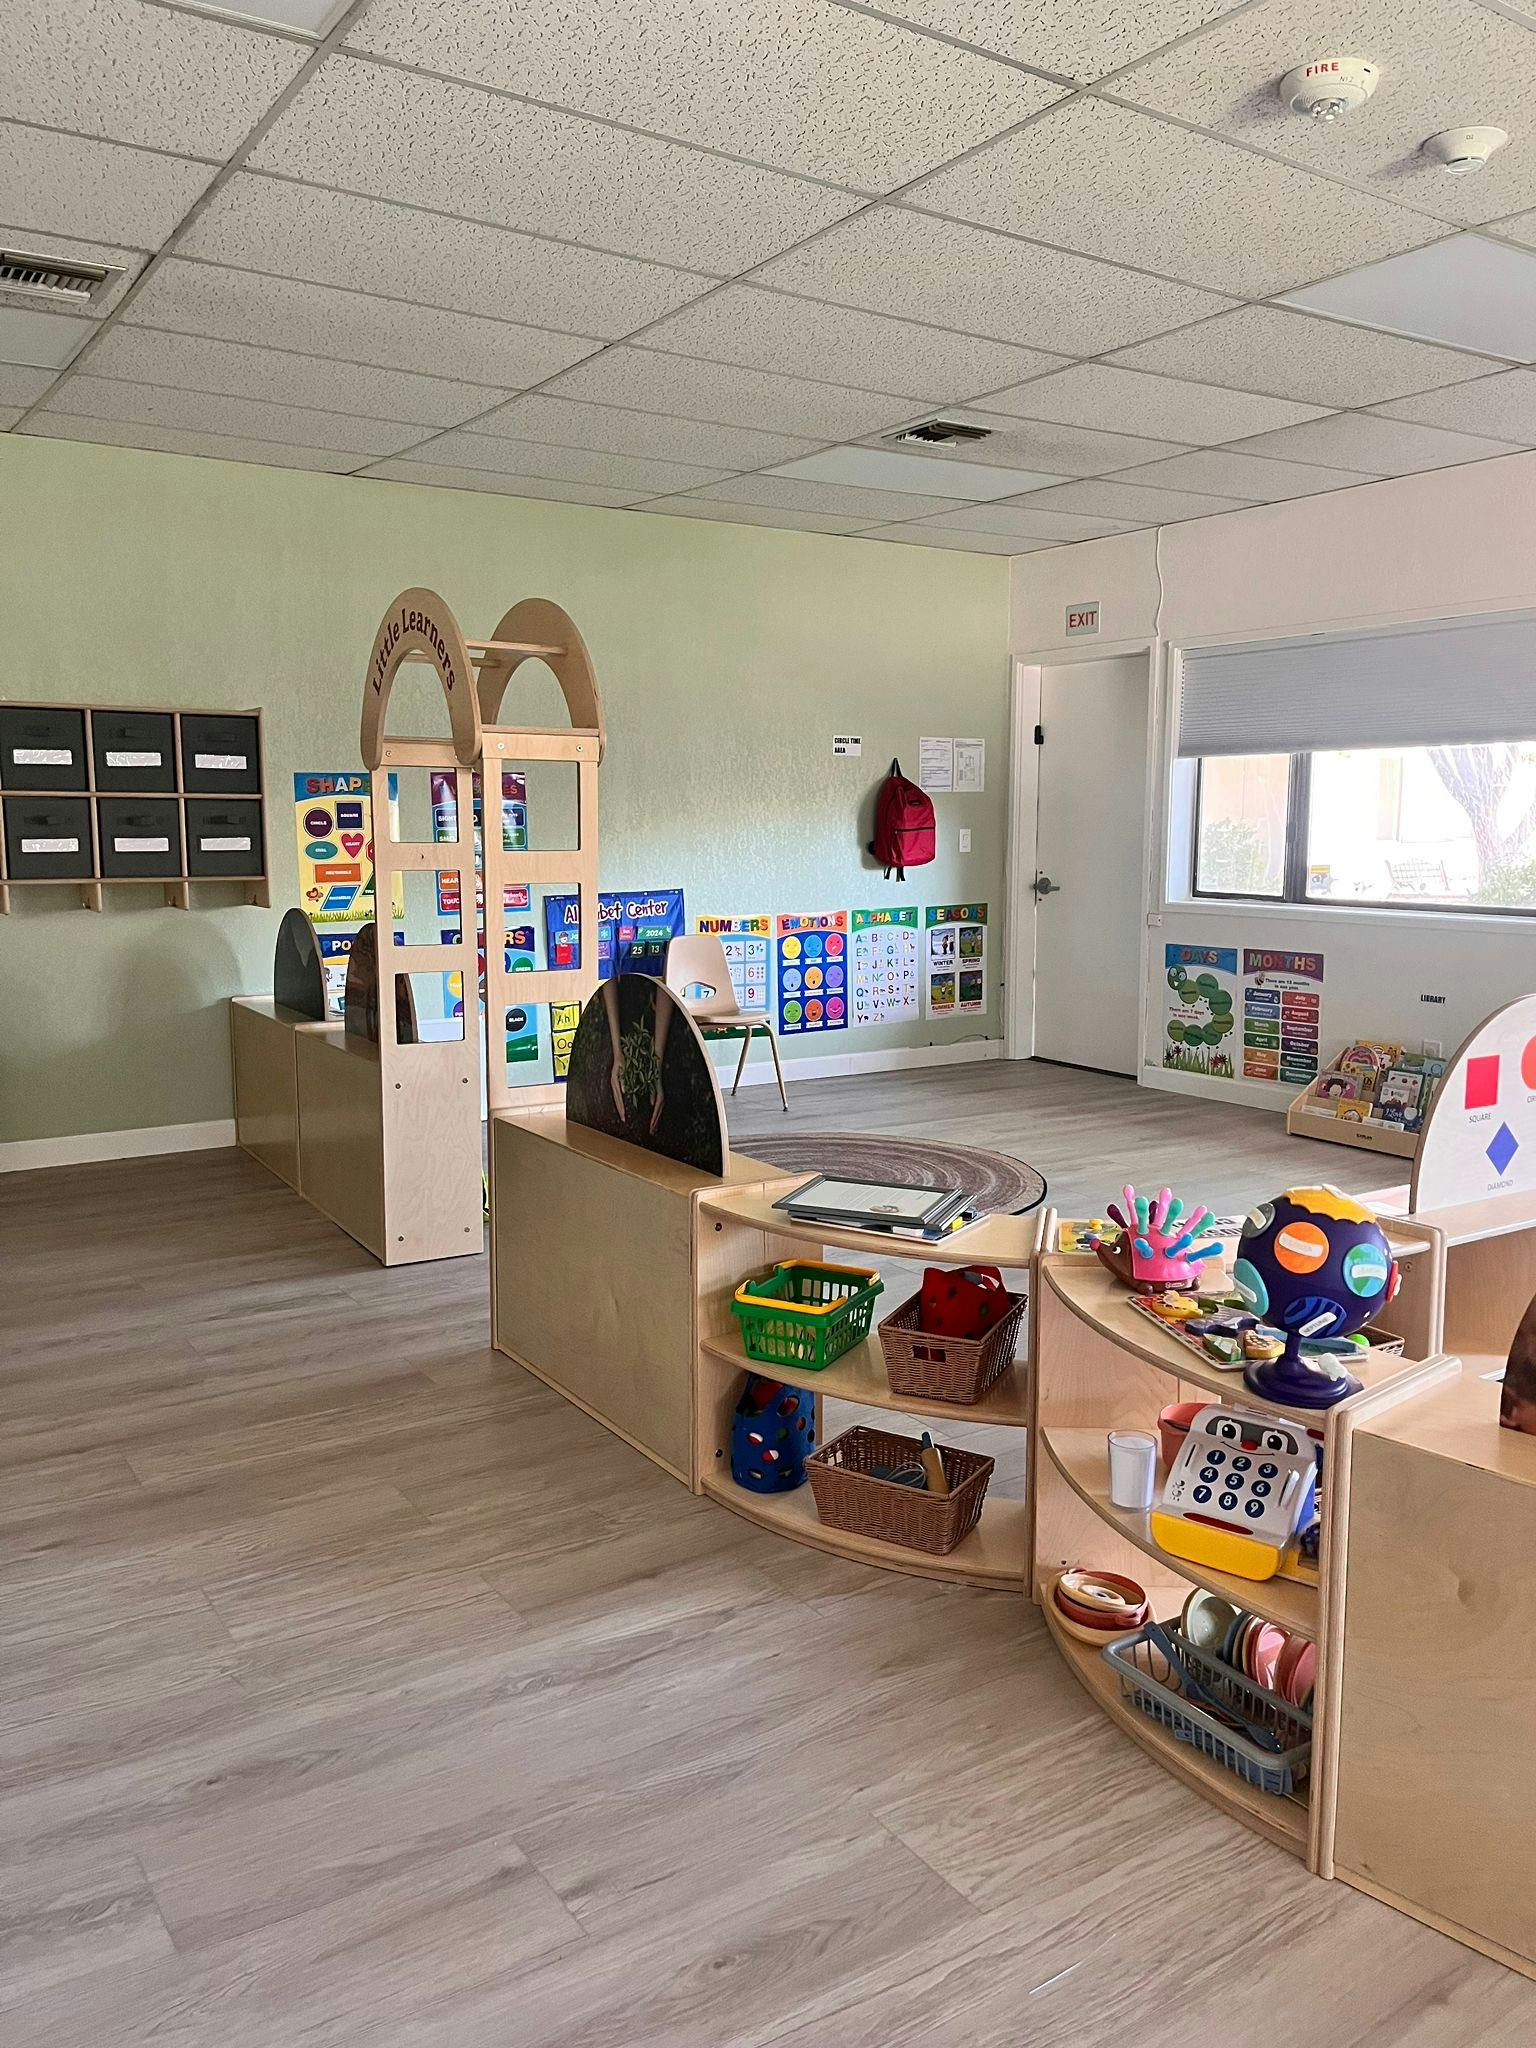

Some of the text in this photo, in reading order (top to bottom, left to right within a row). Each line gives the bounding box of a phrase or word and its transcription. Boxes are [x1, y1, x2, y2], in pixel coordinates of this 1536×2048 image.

[1306, 62, 1339, 77] FIRE
[1069, 611, 1097, 628] EXIT
[373, 608, 455, 696] Little Learners
[627, 901, 667, 917] Center
[928, 905, 985, 921] SEASONS
[782, 916, 843, 930] EMOTIONS
[856, 911, 913, 924] ALPHABET
[700, 919, 769, 932] NUMBERS
[856, 931, 909, 944] A B C D
[632, 945, 659, 954] 25 13
[726, 944, 755, 956] 2 3
[856, 948, 862, 957] E
[887, 945, 894, 955] G
[872, 960, 877, 969] J
[887, 958, 894, 968] K
[903, 957, 908, 966] L
[1182, 950, 1217, 963] DAYS
[1249, 953, 1316, 971] MONTHS
[748, 967, 755, 978] 6
[873, 973, 879, 982] N
[887, 971, 894, 981] O
[903, 970, 909, 980] P
[748, 987, 755, 999] 9
[856, 987, 864, 997] Q
[873, 986, 879, 996] R
[888, 984, 894, 994] S
[857, 996, 909, 1010] U V W X
[1421, 994, 1445, 1003] LIBRARY
[857, 1013, 879, 1023] Y Z
[1469, 1112, 1492, 1123] SQUARE
[1487, 1180, 1513, 1191] DIAMOND
[1214, 1452, 1271, 1473] 1 2 3
[1204, 1470, 1265, 1492] 4 5 6
[1199, 1489, 1258, 1513] 7 8 9
